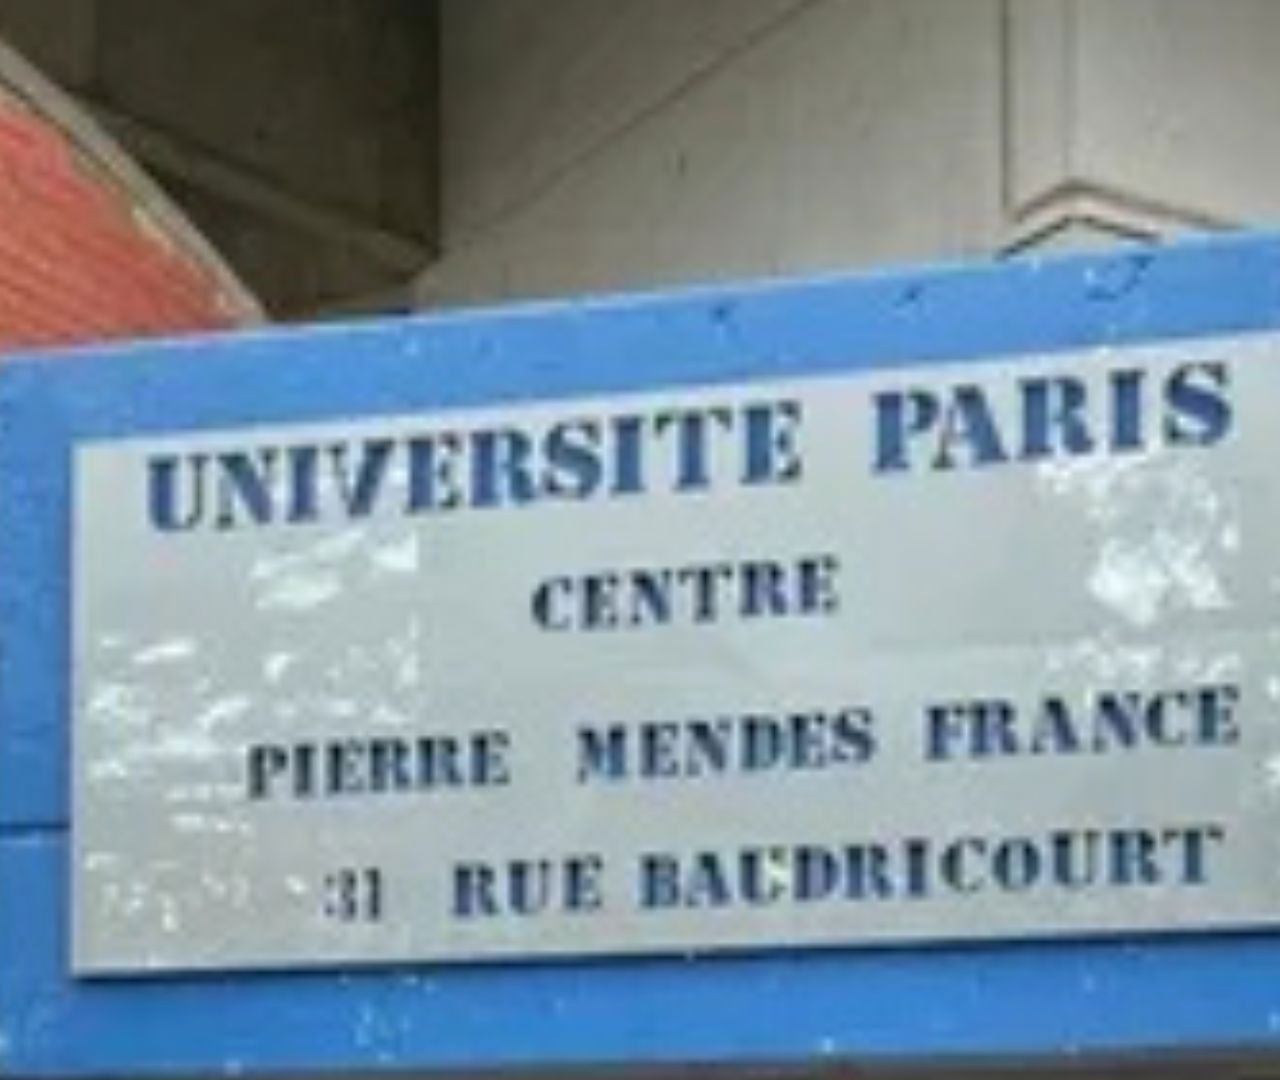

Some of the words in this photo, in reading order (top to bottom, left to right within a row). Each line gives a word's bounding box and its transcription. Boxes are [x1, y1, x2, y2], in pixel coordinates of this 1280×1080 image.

[147, 399, 801, 531] UNIVERSITE
[874, 360, 1233, 473] PARIS
[530, 555, 837, 631] CENTRE
[247, 730, 511, 799] PIERRE
[576, 708, 876, 782] MENDES
[924, 683, 1241, 762] FRANCE
[324, 867, 383, 921] 31
[451, 855, 604, 919] RUE
[639, 824, 1226, 911] BAUDRICOURT
